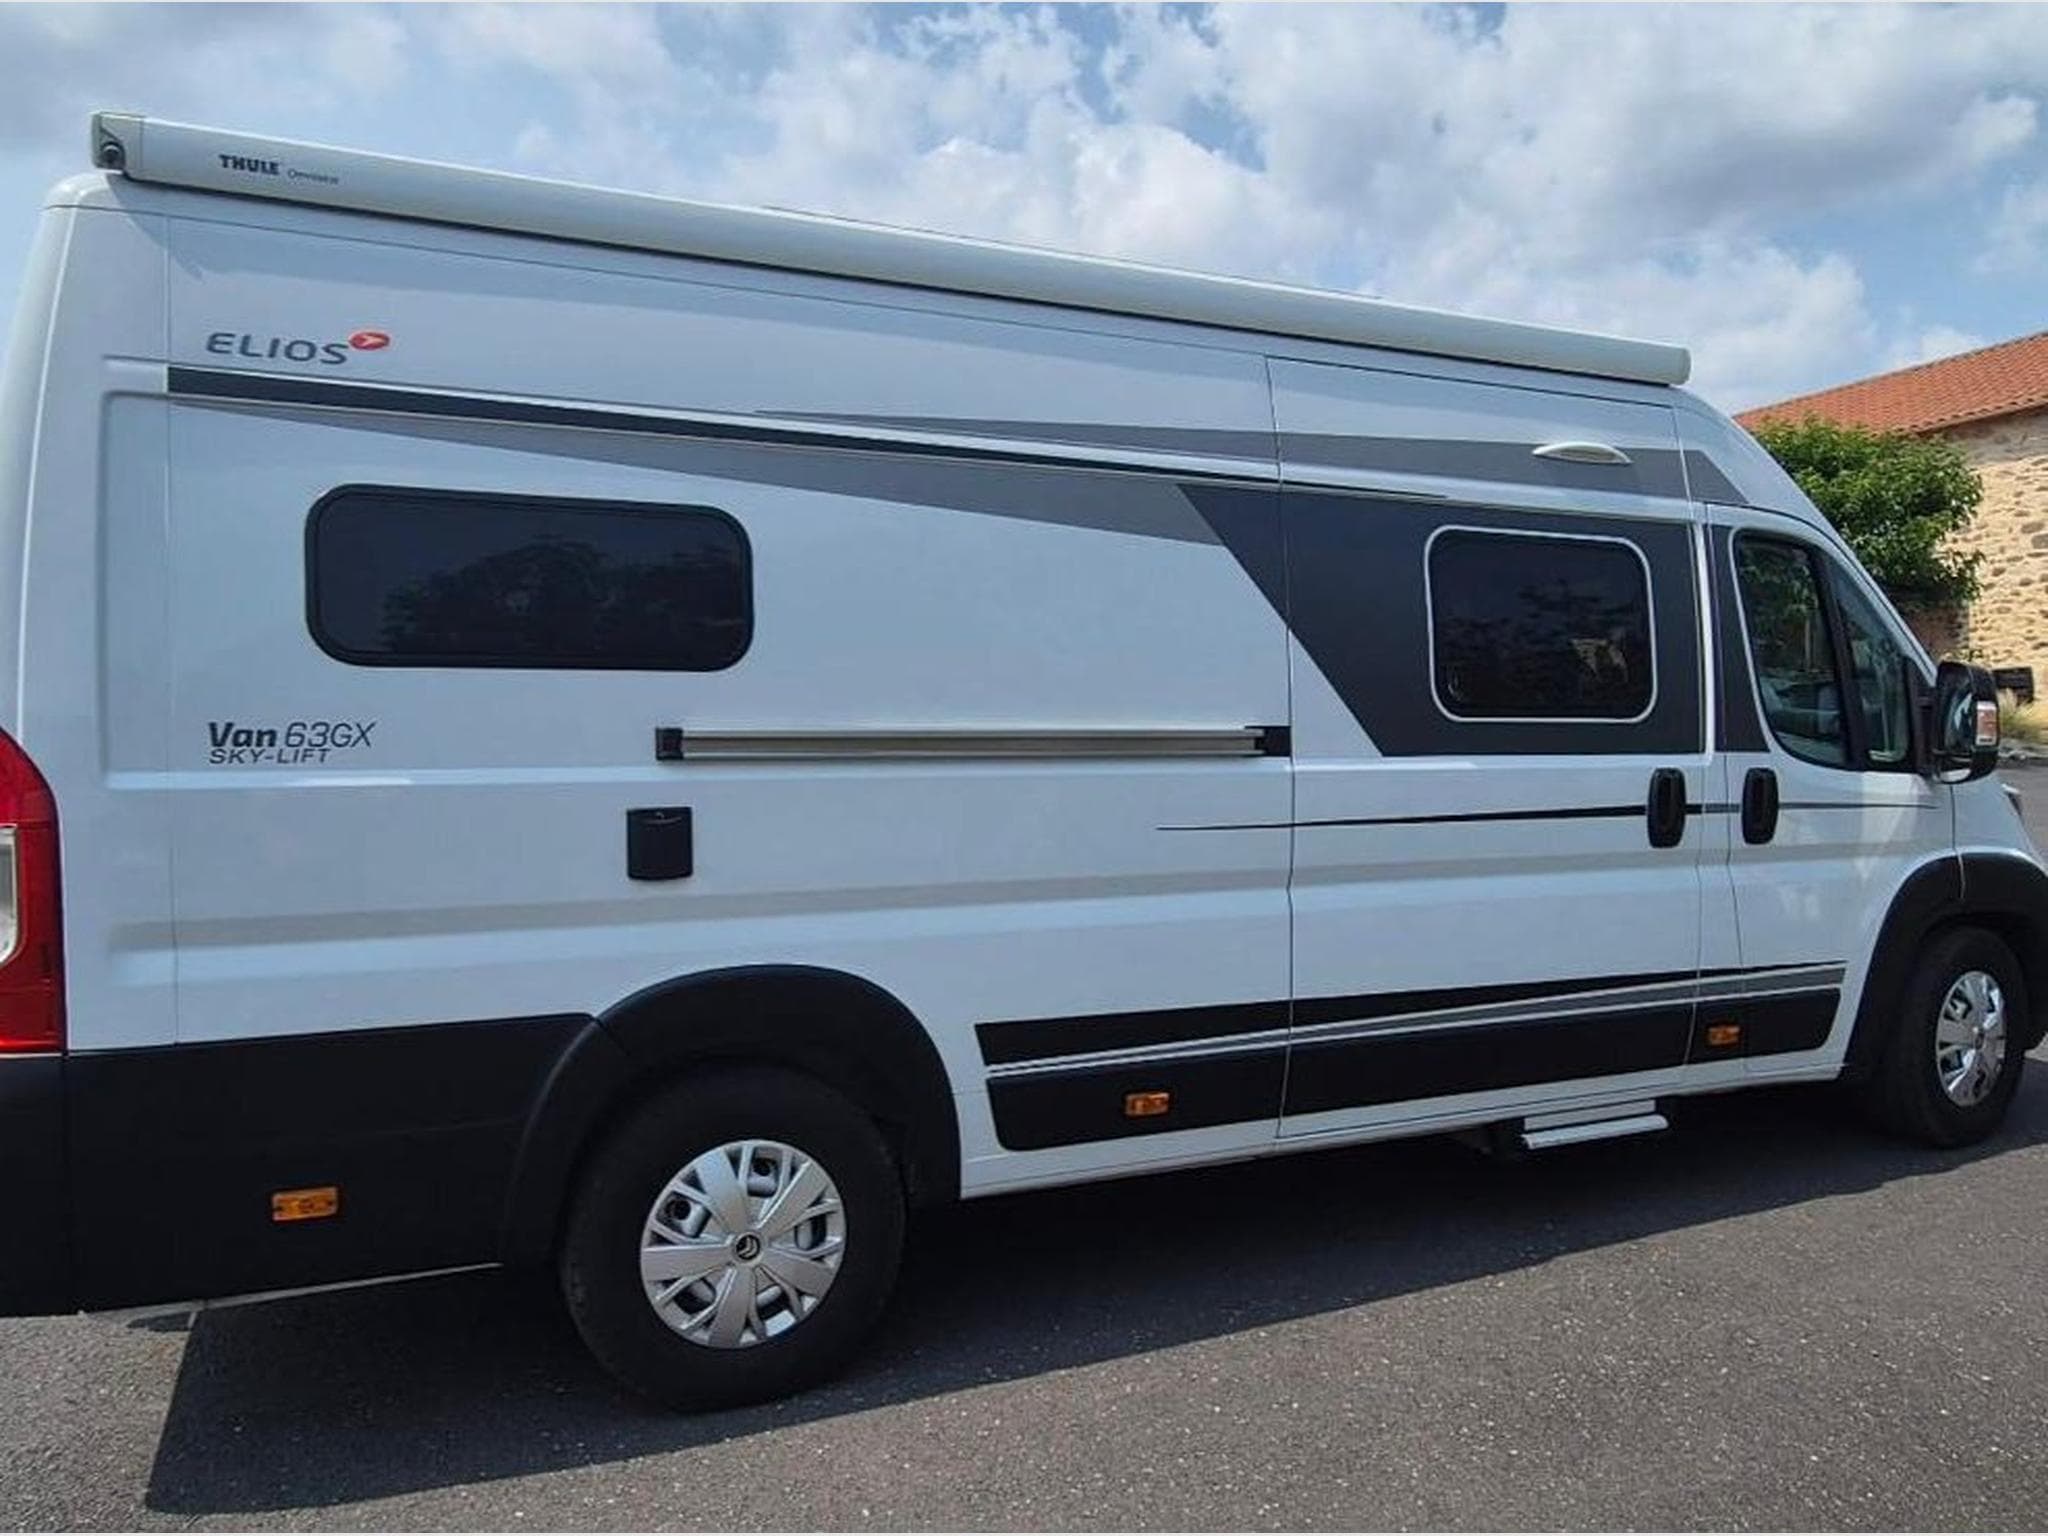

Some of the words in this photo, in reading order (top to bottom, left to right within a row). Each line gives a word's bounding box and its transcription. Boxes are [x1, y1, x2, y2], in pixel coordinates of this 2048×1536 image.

[218, 154, 280, 176] THULE
[206, 332, 349, 364] ELIOS
[208, 722, 278, 748] Van
[284, 721, 376, 748] 63GX
[208, 748, 332, 764] SKY-LIFT
